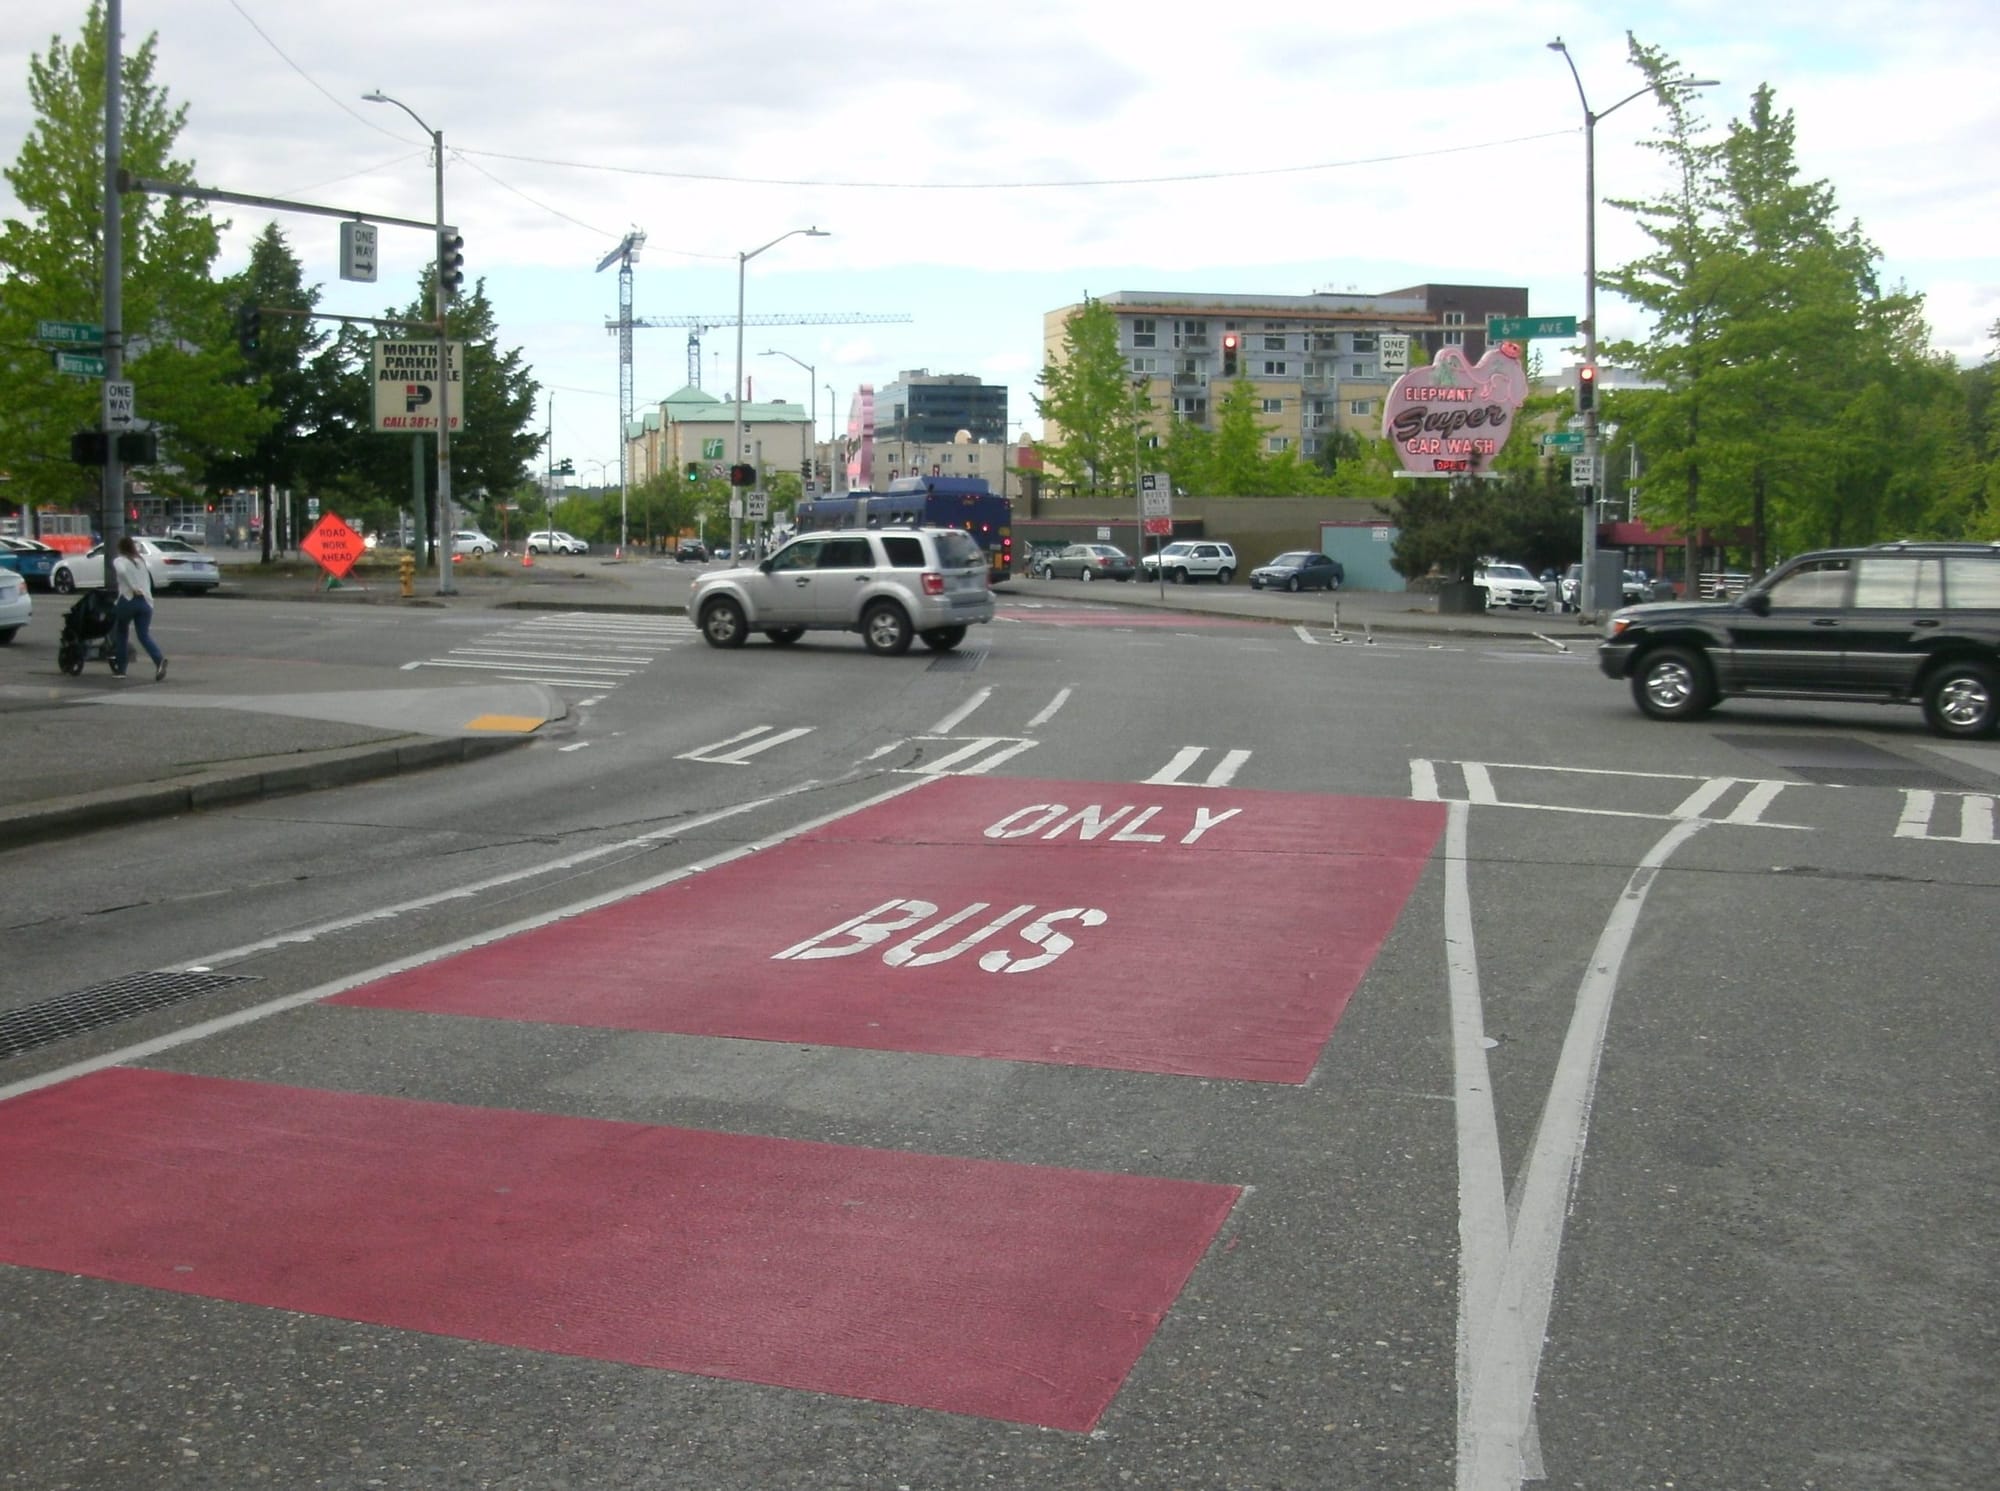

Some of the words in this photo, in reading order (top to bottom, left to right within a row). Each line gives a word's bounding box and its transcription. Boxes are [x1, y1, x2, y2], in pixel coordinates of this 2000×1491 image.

[355, 230, 375, 244] ONE
[355, 244, 375, 258] WAY
[41, 321, 77, 341] Battery
[1538, 322, 1564, 334] AVE
[383, 344, 455, 356] MONTHY
[1383, 340, 1405, 349] ONE
[1383, 350, 1405, 359] WAY
[379, 370, 460, 382] AVAILALE
[108, 385, 131, 397] ONE
[1405, 387, 1474, 402] ELEPHANT
[108, 400, 131, 410] WAY
[383, 416, 407, 428] CALL
[1393, 405, 1507, 443] Super
[1406, 438, 1441, 455] CAR
[1446, 438, 1495, 455] WASH
[1575, 458, 1592, 466] ONE
[749, 502, 765, 510] WAY
[320, 528, 346, 537] ROAD
[321, 541, 347, 549] WORK
[322, 552, 352, 561] AHEAD
[983, 804, 1243, 845] ONLY
[770, 899, 1108, 973] BUS
